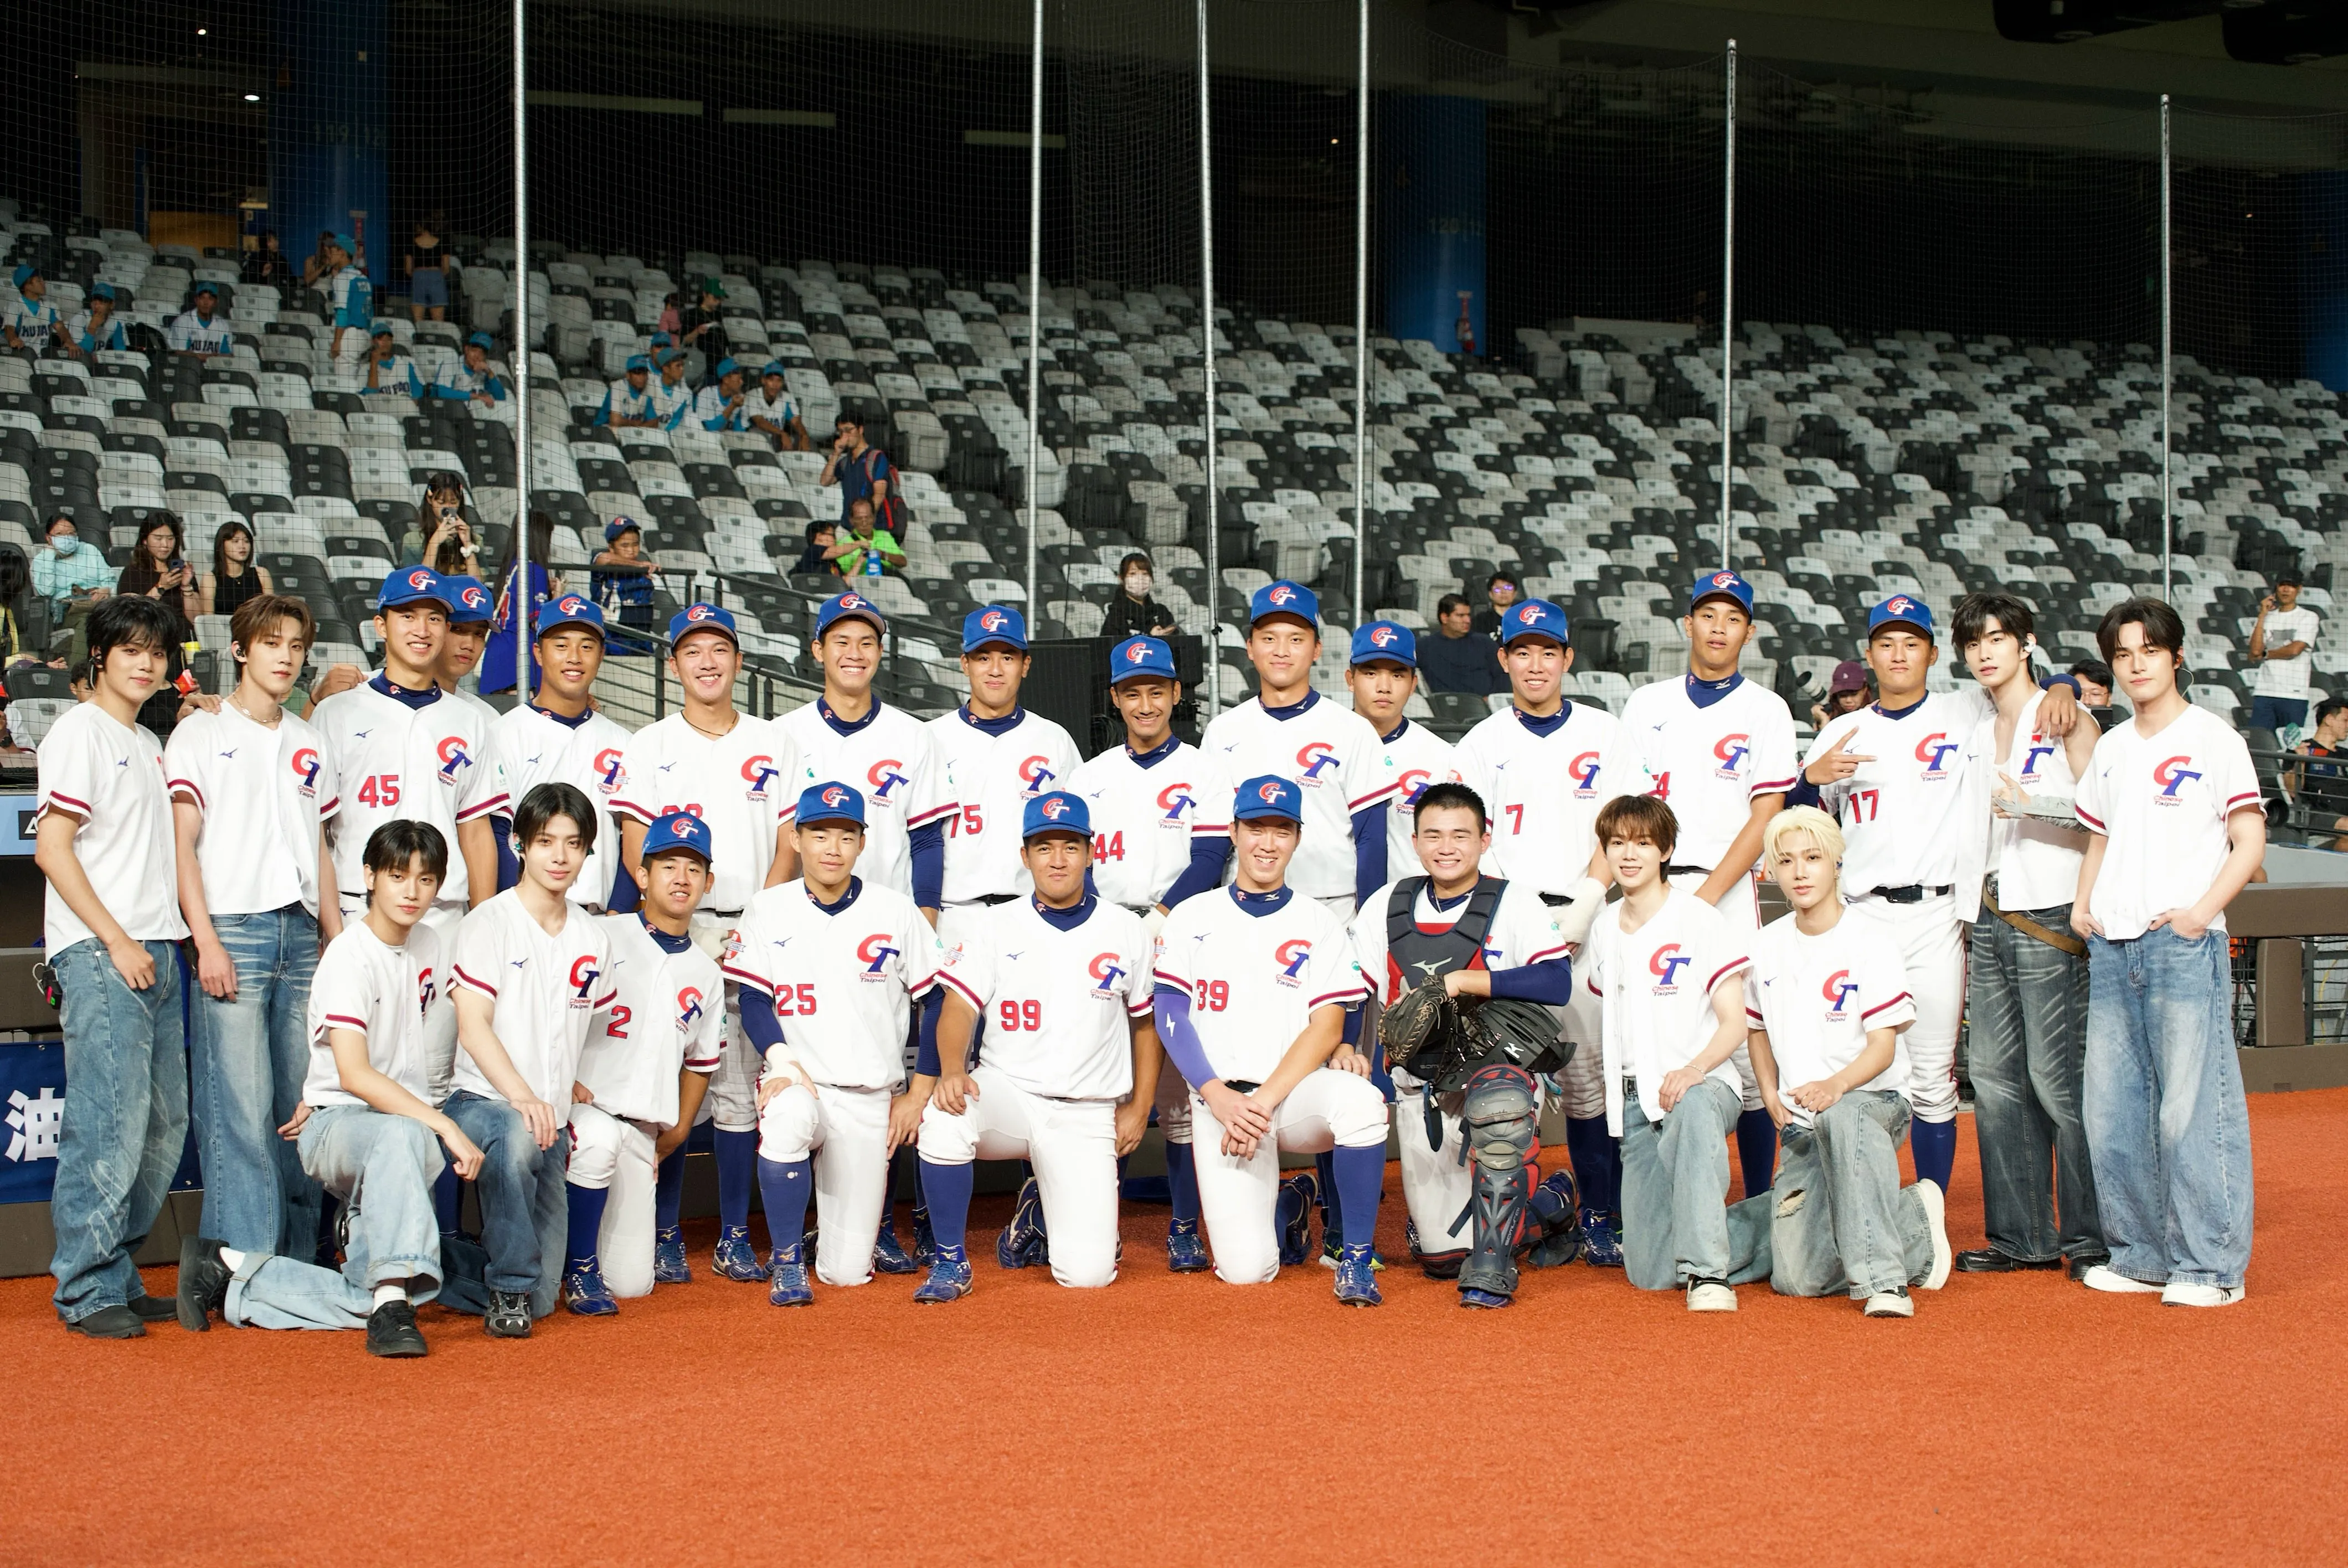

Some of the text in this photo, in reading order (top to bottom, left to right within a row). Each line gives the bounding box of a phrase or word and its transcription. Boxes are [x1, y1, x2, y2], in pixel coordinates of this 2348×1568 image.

[1295, 776, 1324, 785] Chinese
[1295, 780, 1321, 788] Taipei
[1714, 768, 1741, 776] Chinese
[358, 775, 400, 808] 45
[868, 795, 893, 804] Chinese
[868, 800, 890, 809] Taipei
[1850, 789, 1879, 824] 17
[1506, 804, 1523, 835] 7
[1094, 831, 1125, 864] 44
[1276, 974, 1302, 985] Chinese
[1276, 979, 1299, 989] Taipei
[775, 984, 817, 1017] 25
[1197, 979, 1229, 1012] 39
[607, 1005, 632, 1039] 2
[1001, 999, 1041, 1031] 99
[4, 1087, 65, 1162] 油
